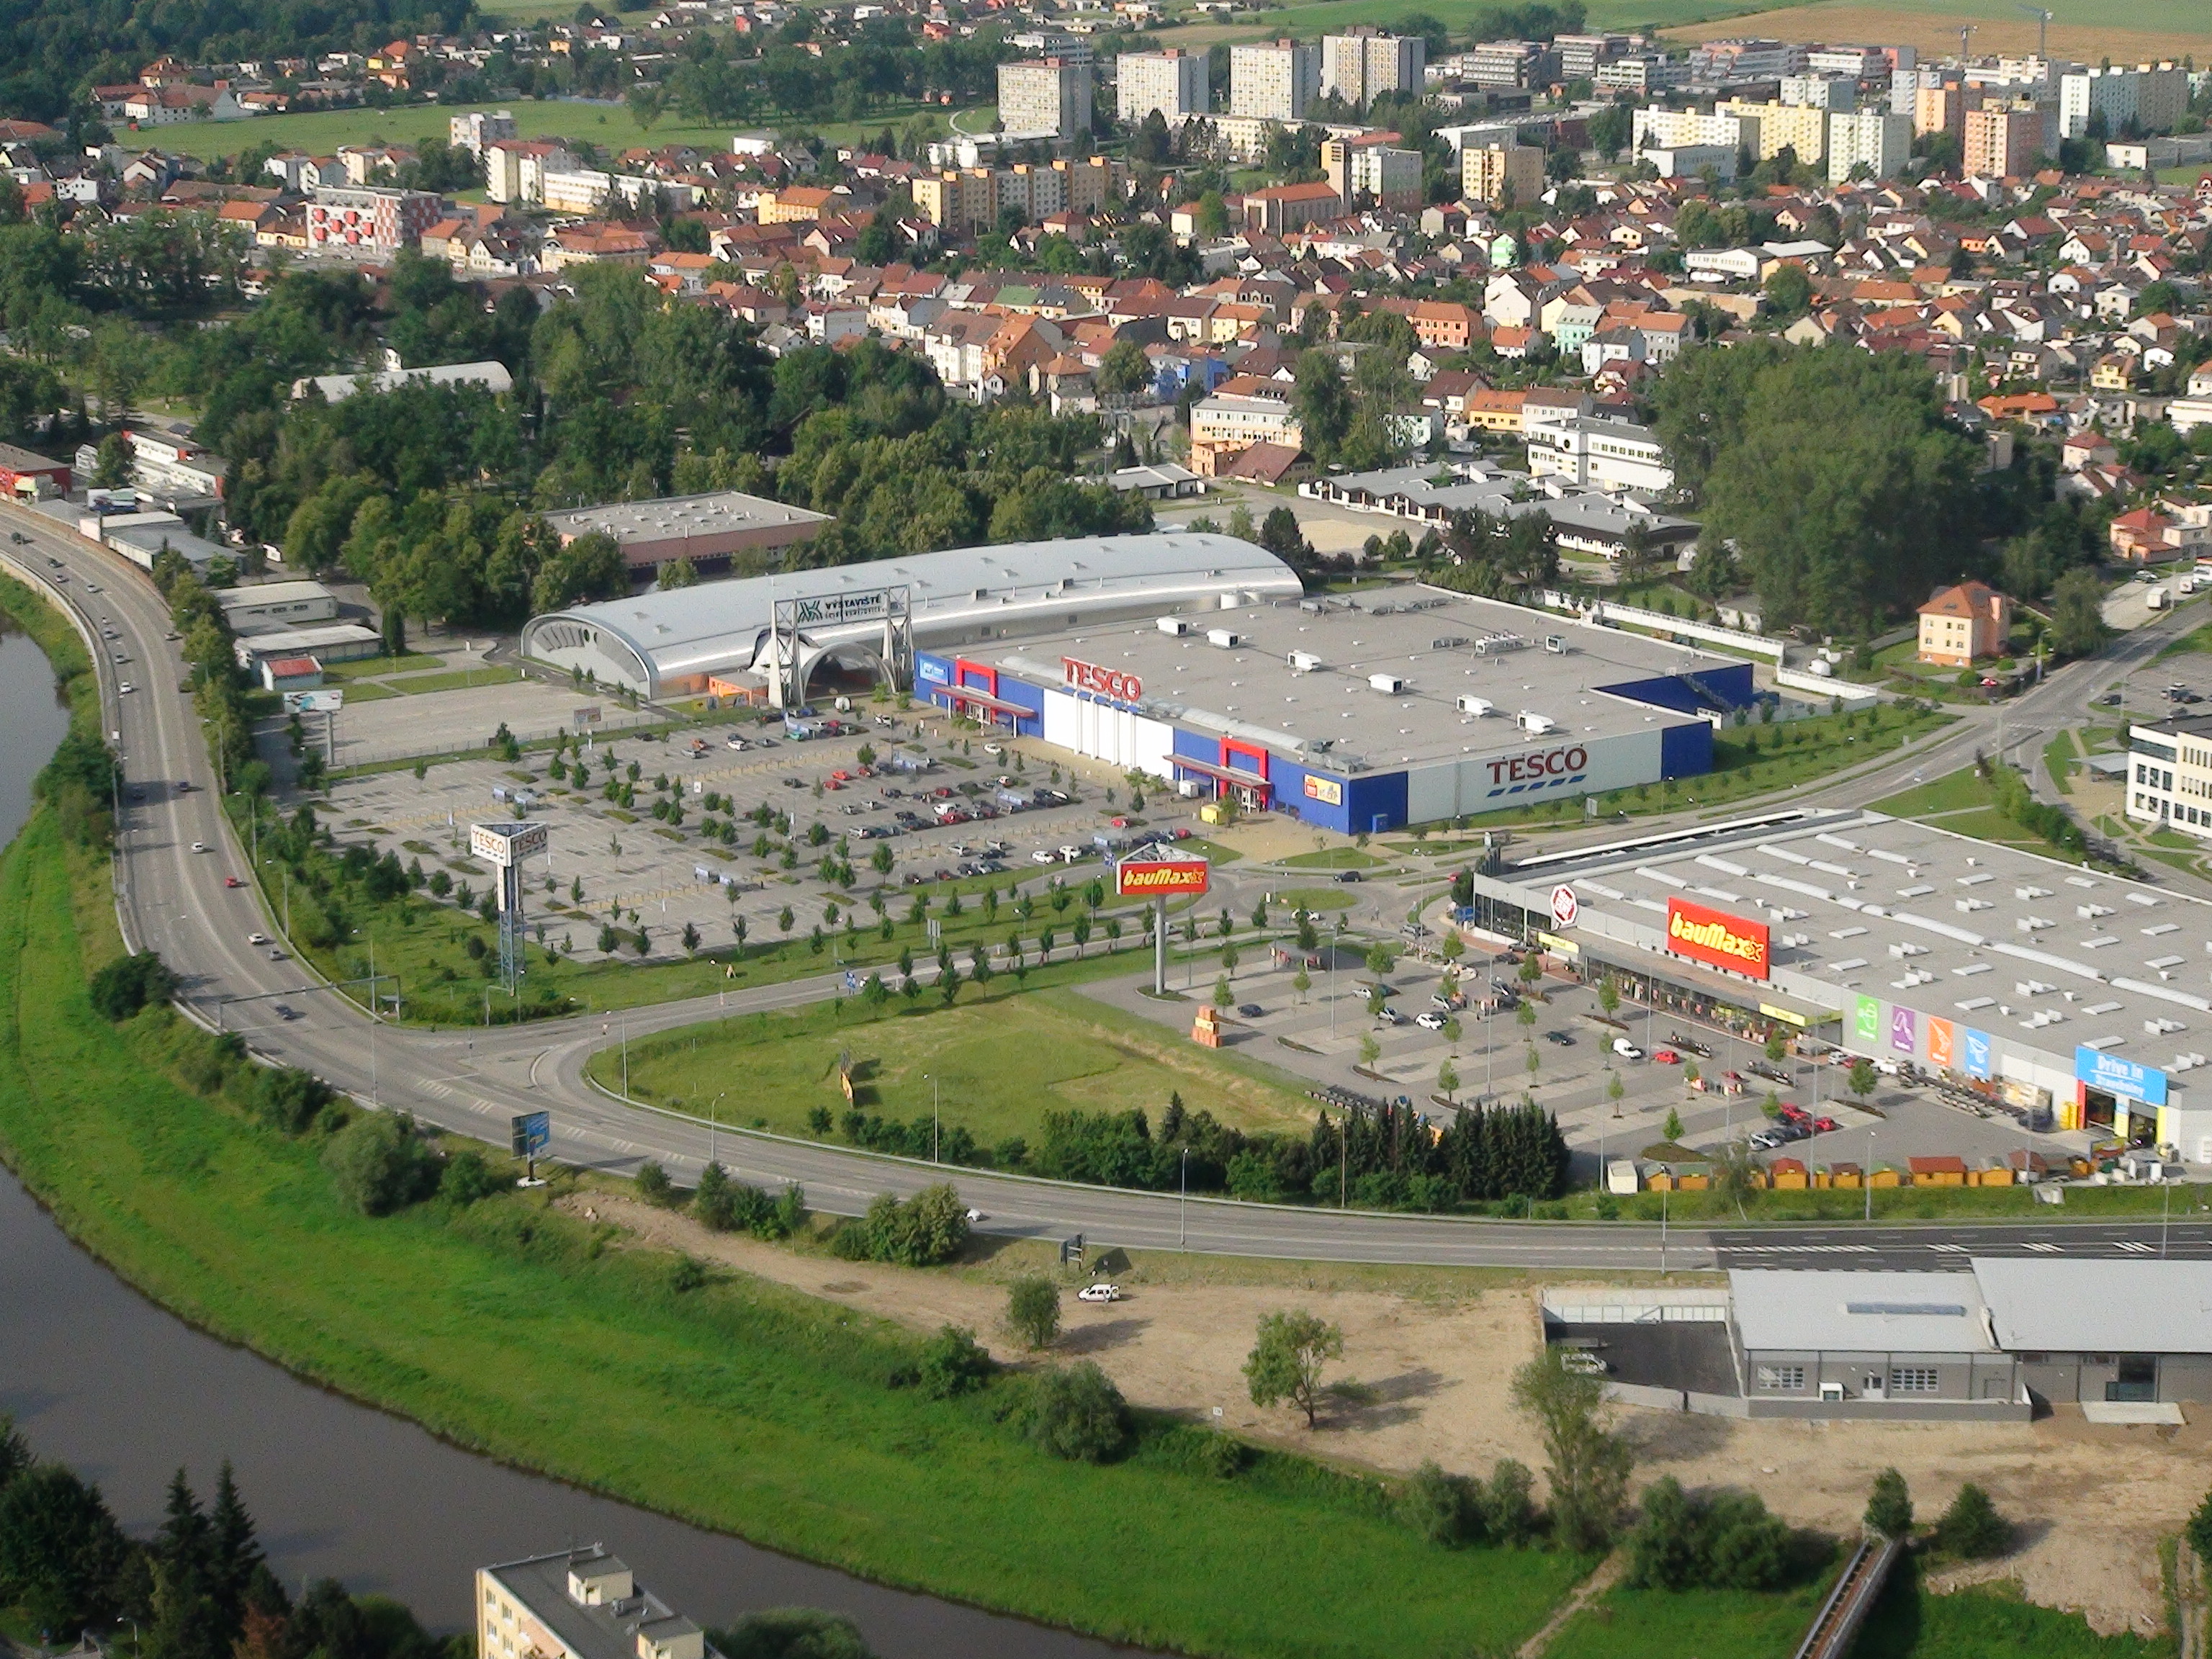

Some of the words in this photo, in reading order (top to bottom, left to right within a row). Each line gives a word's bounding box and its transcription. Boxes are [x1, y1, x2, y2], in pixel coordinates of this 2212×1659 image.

[1061, 656, 1141, 702] TESCO
[1487, 748, 1587, 783] TESCO
[472, 830, 504, 853] TESCO
[513, 829, 547, 853] TESCO
